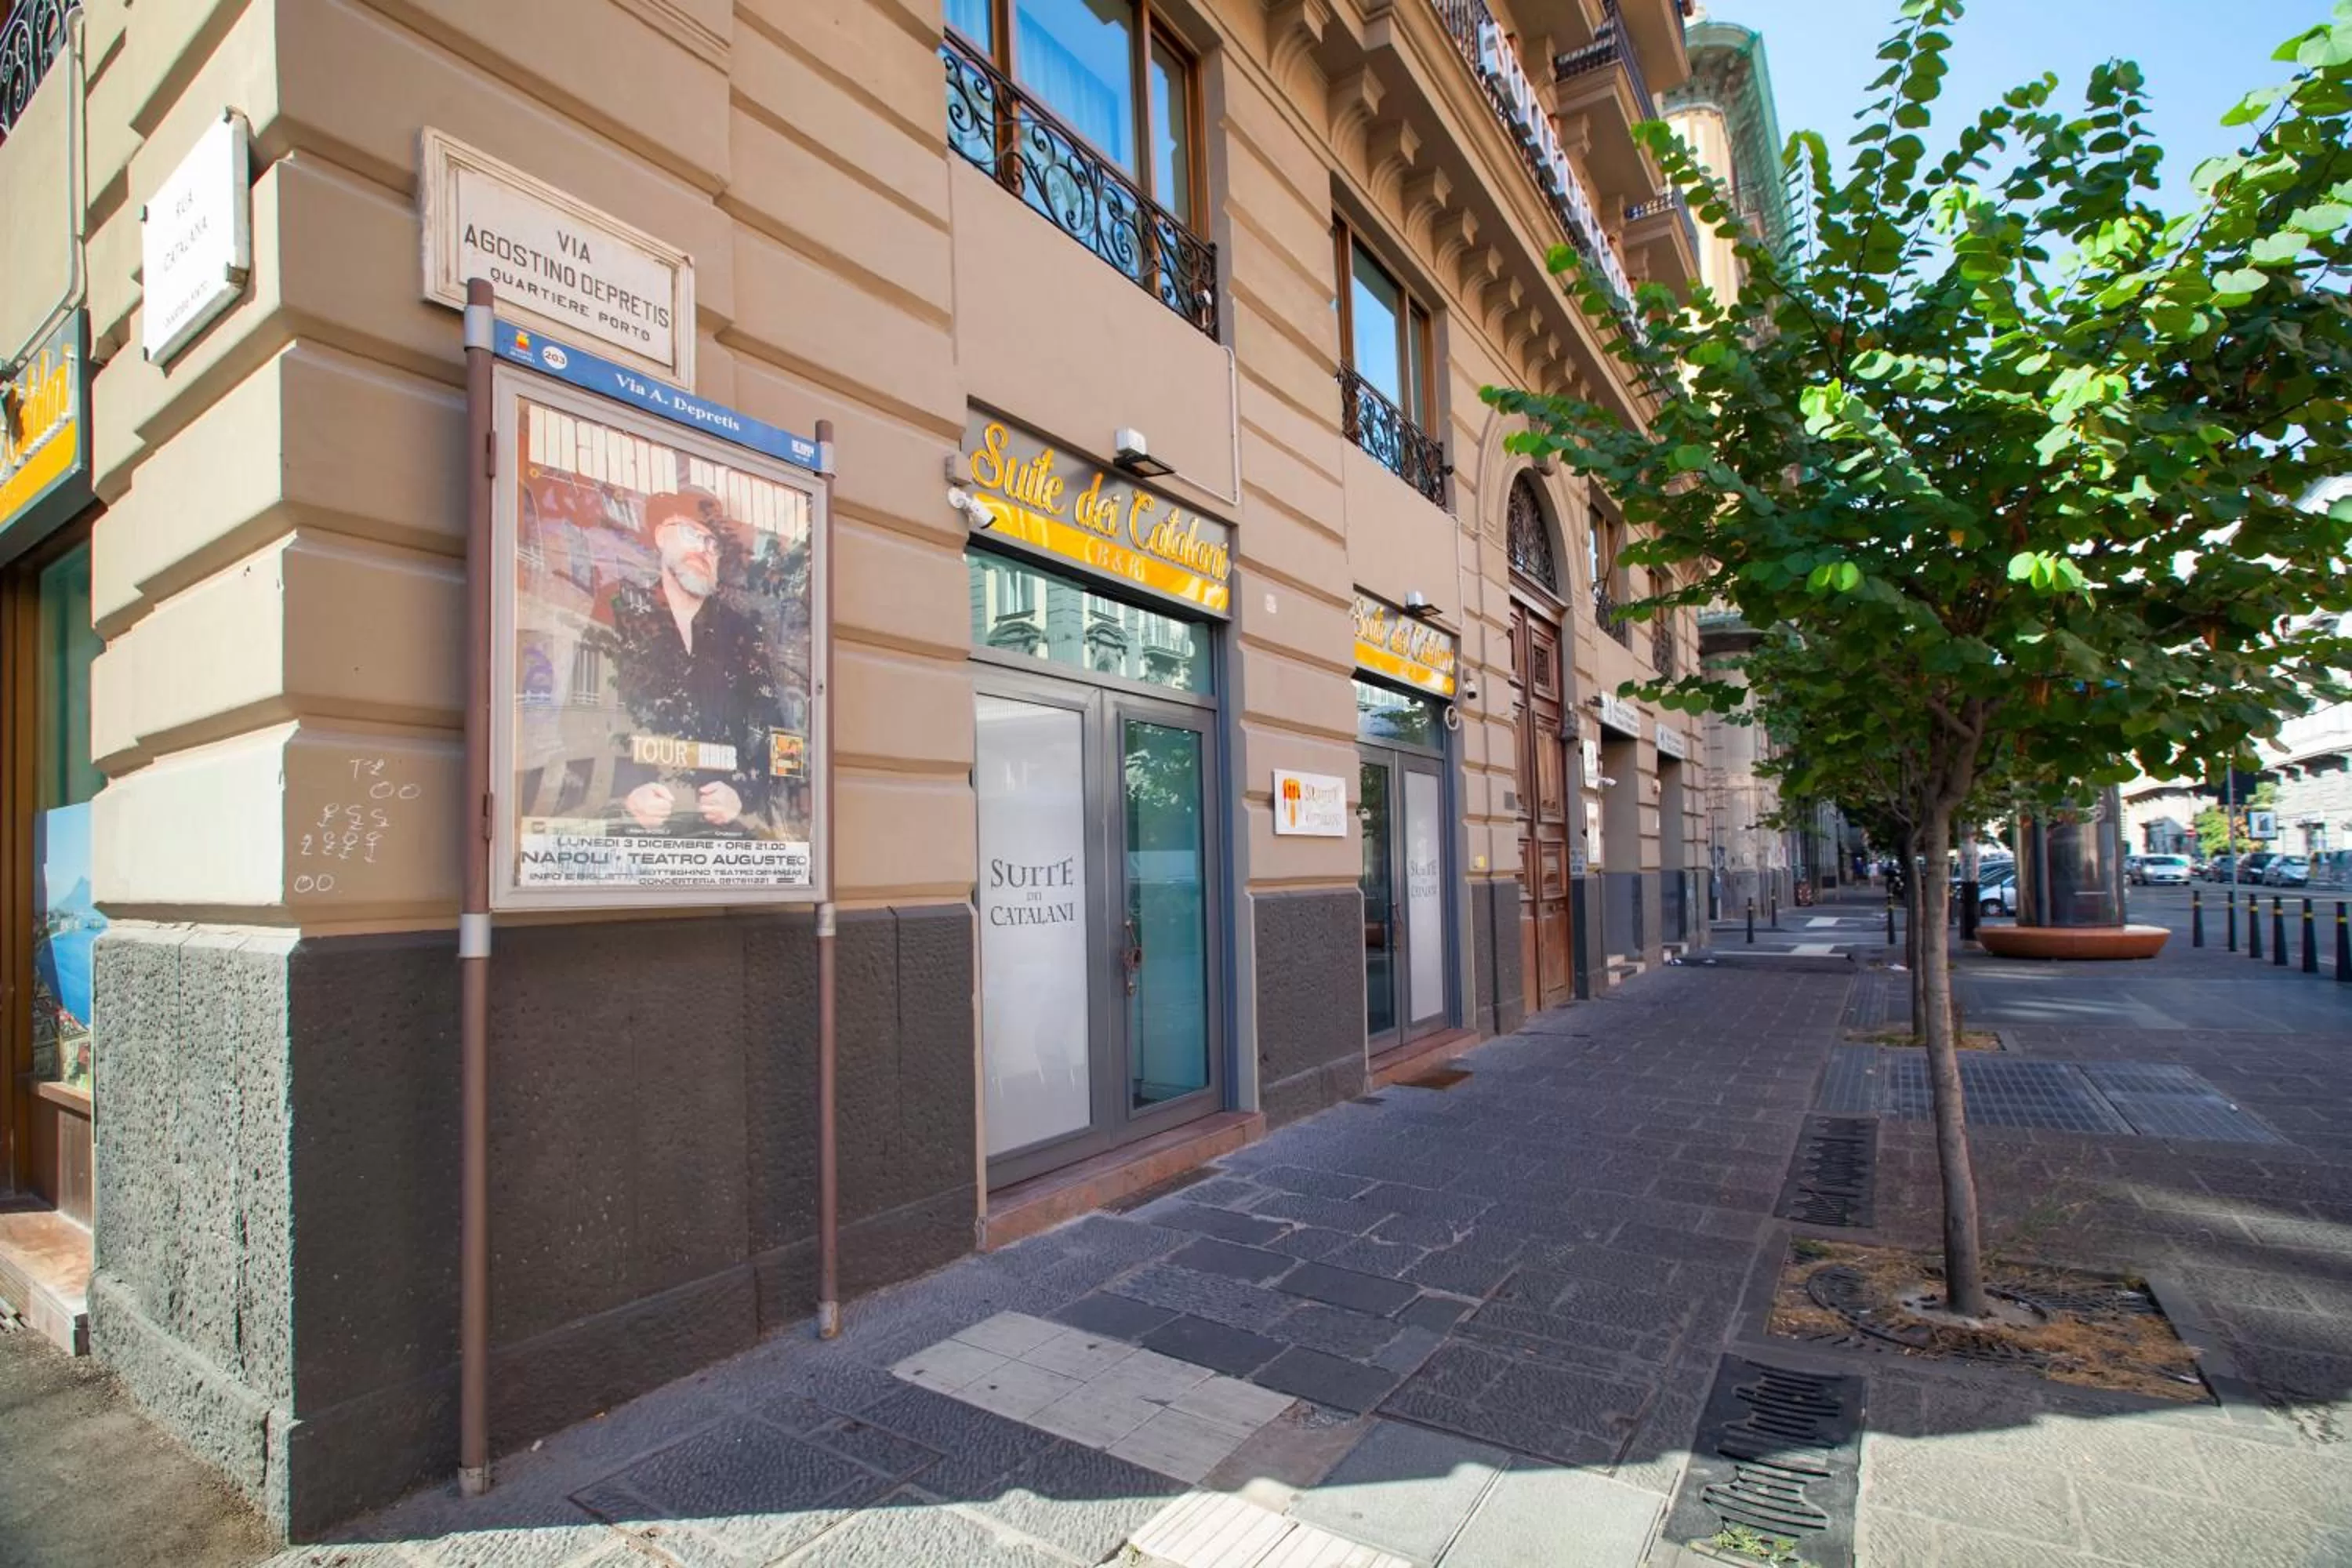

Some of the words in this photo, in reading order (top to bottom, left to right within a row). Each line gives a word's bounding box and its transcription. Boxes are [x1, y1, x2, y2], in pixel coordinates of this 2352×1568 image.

[557, 230, 591, 264] VIA
[464, 223, 575, 288] AGOSTINO
[581, 274, 669, 328] DEPRETIS
[490, 268, 590, 318] QUARTIERE
[599, 310, 651, 342] PORTO
[544, 350, 566, 365] 203
[615, 373, 645, 396] Via
[649, 388, 668, 405] A.
[673, 396, 740, 431] Depretis
[970, 421, 1067, 516] Suite
[1075, 471, 1122, 538] dei
[1127, 488, 1232, 581] Catalani
[632, 735, 688, 767] TOUR
[521, 851, 608, 863] NAPOLI
[628, 852, 707, 864] TEATRO
[713, 854, 808, 866] AUGUSTEO
[557, 837, 619, 848] LUNEDI
[623, 838, 633, 848] 3
[637, 840, 714, 849] DICEMBRE
[725, 841, 752, 851] ORE
[990, 857, 1074, 890] SUITE
[990, 903, 1076, 927] CATALANI
